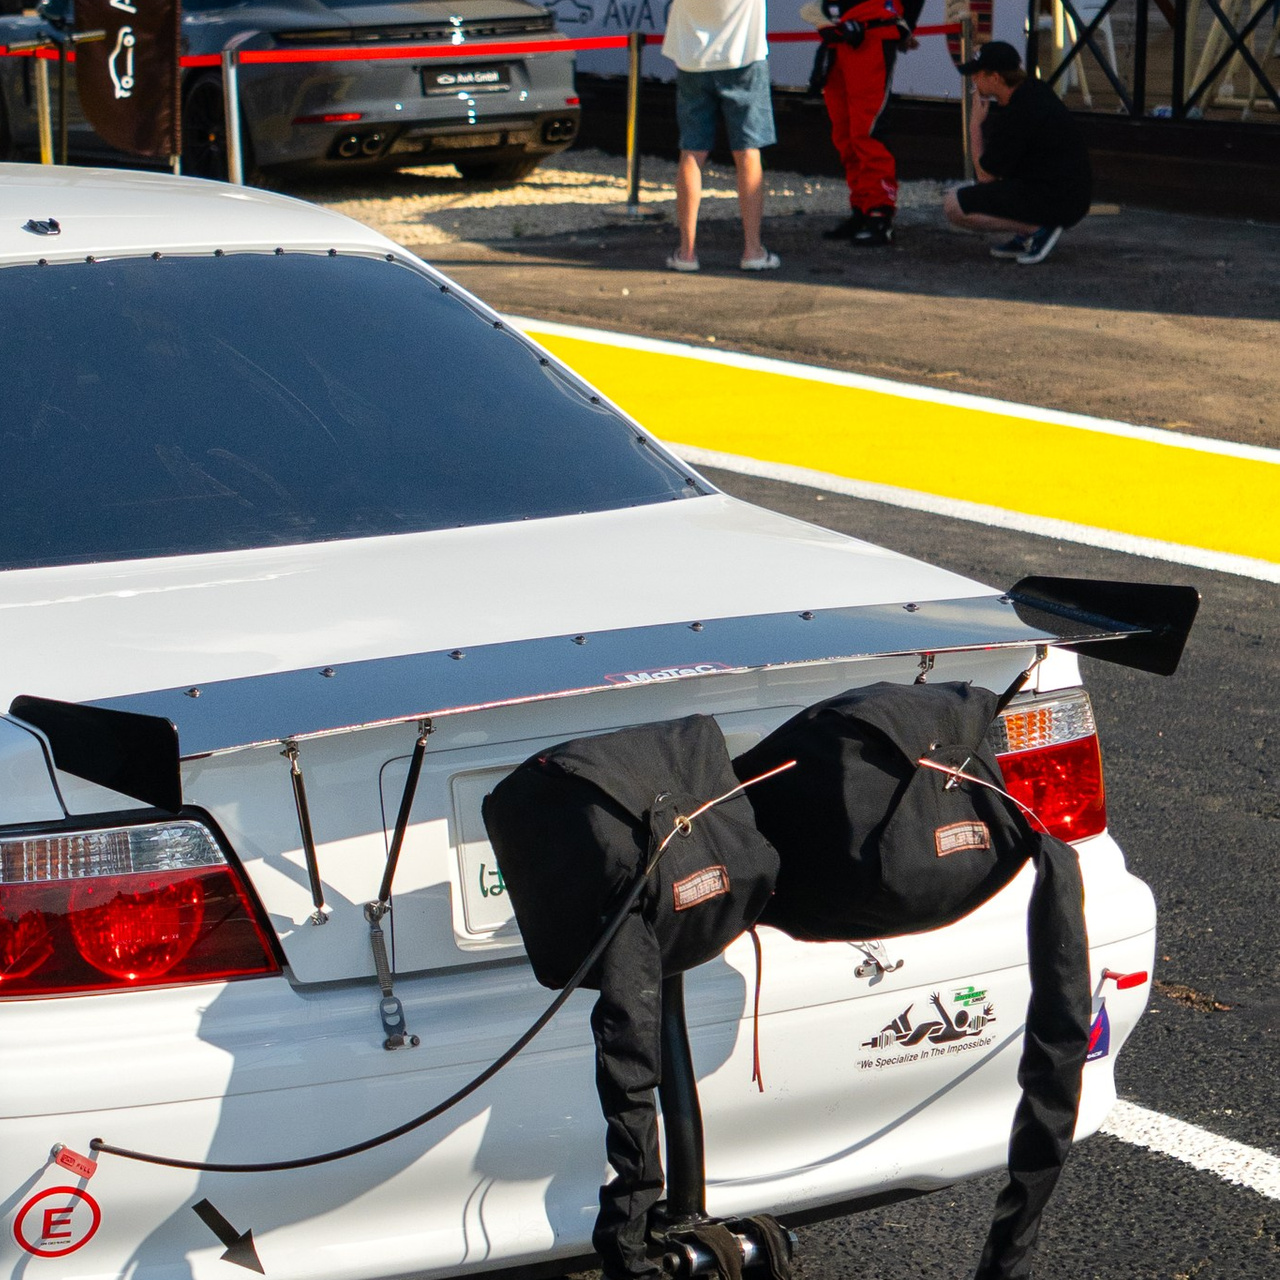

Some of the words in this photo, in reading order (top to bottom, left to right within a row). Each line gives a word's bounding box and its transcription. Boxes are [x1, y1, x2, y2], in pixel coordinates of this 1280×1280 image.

[623, 664, 717, 684] MoTeC
[479, 863, 507, 898] は
[874, 1052, 919, 1069] Specialize
[920, 1050, 929, 1060] In
[930, 1047, 946, 1057] The
[41, 1206, 74, 1240] E
